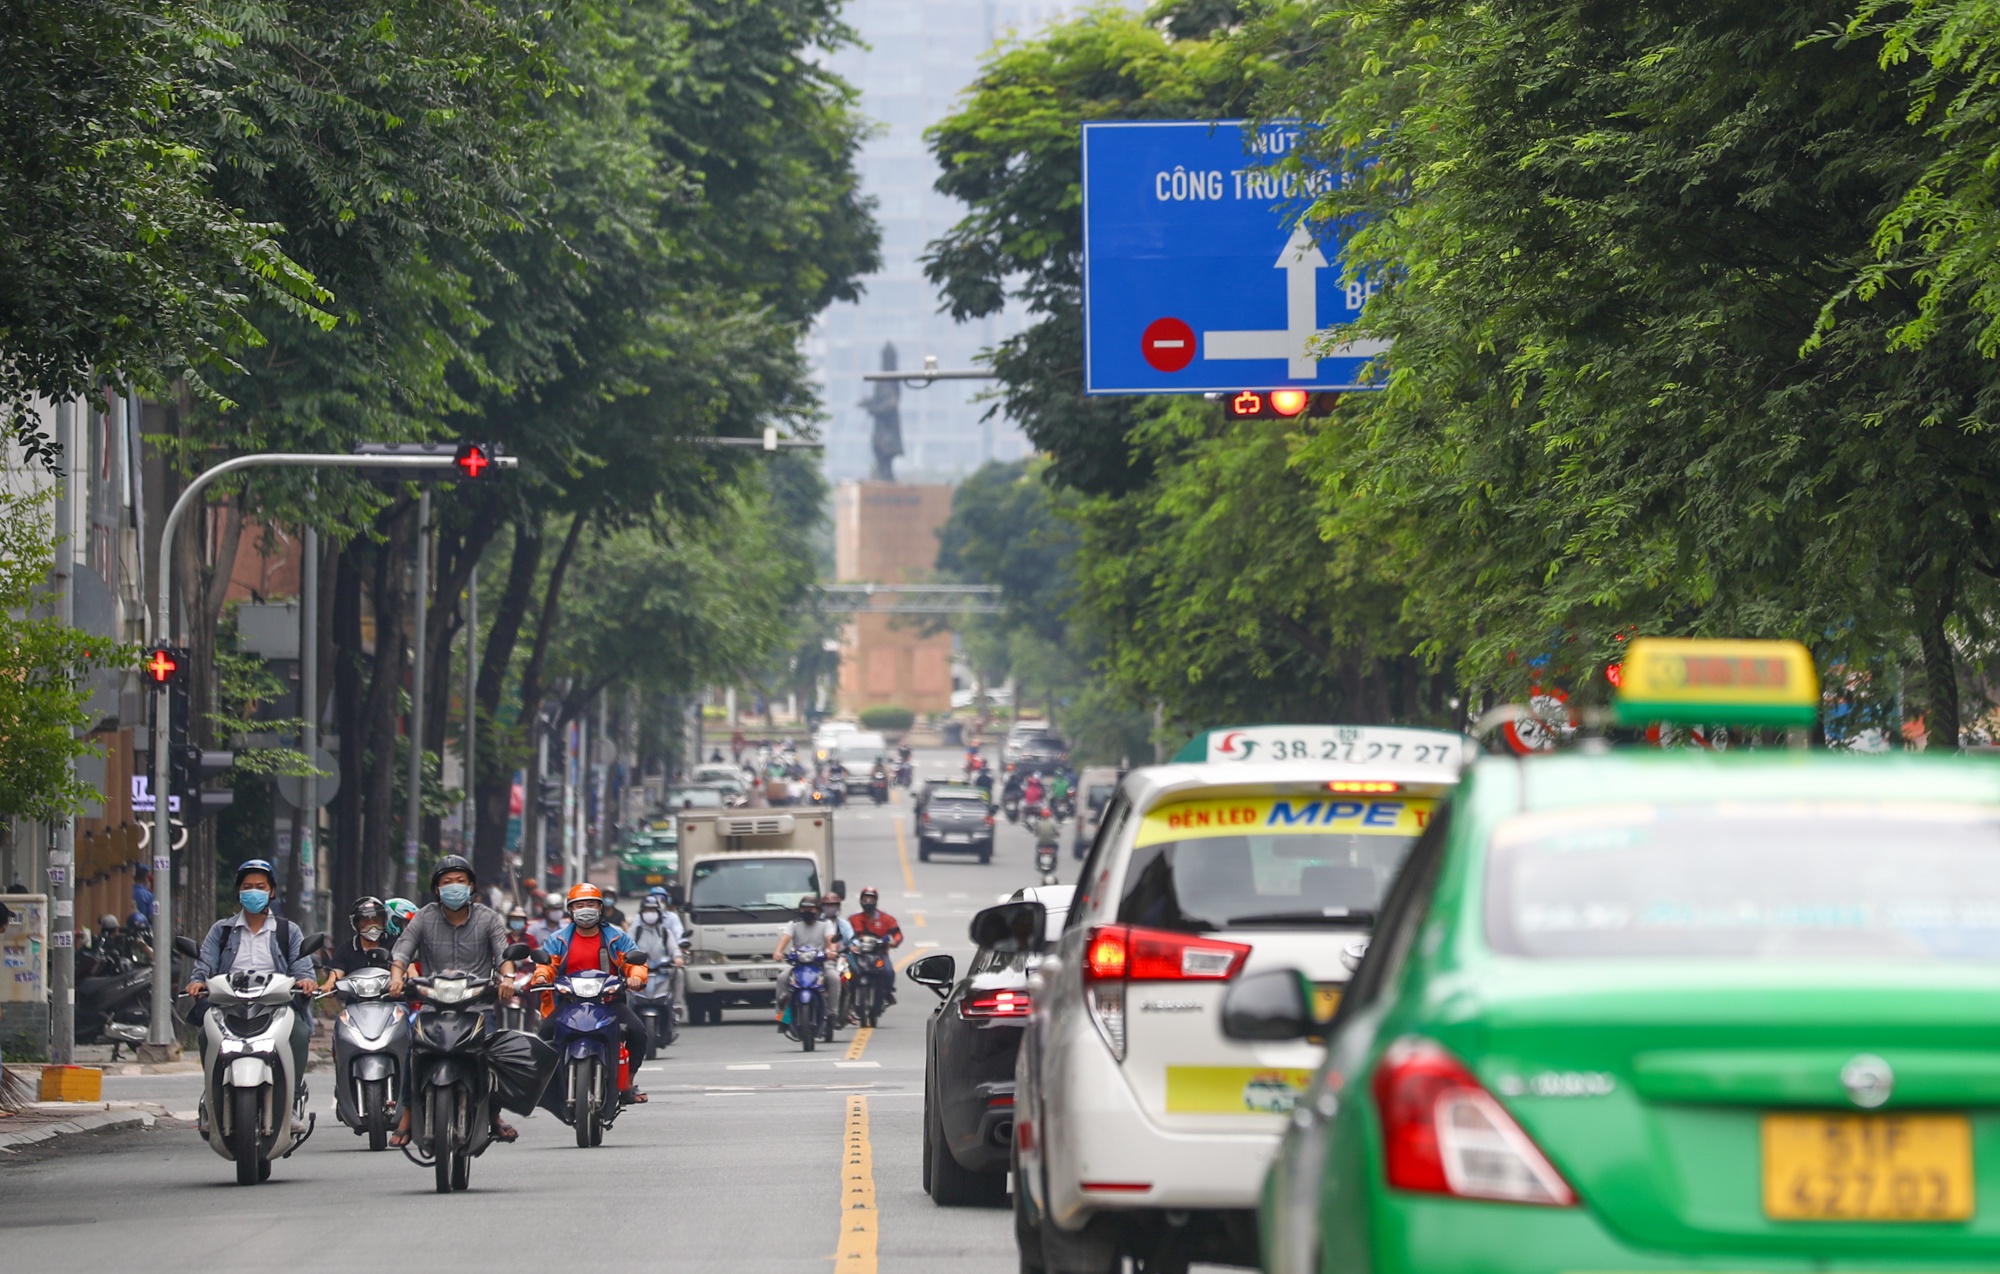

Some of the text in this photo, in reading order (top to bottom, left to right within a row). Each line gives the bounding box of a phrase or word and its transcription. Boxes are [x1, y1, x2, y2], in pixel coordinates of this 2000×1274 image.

[1252, 127, 1300, 154] NÚT
[1156, 165, 1223, 201] CÔNG
[1217, 806, 1258, 826] LED
[1266, 801, 1404, 828] MPE
